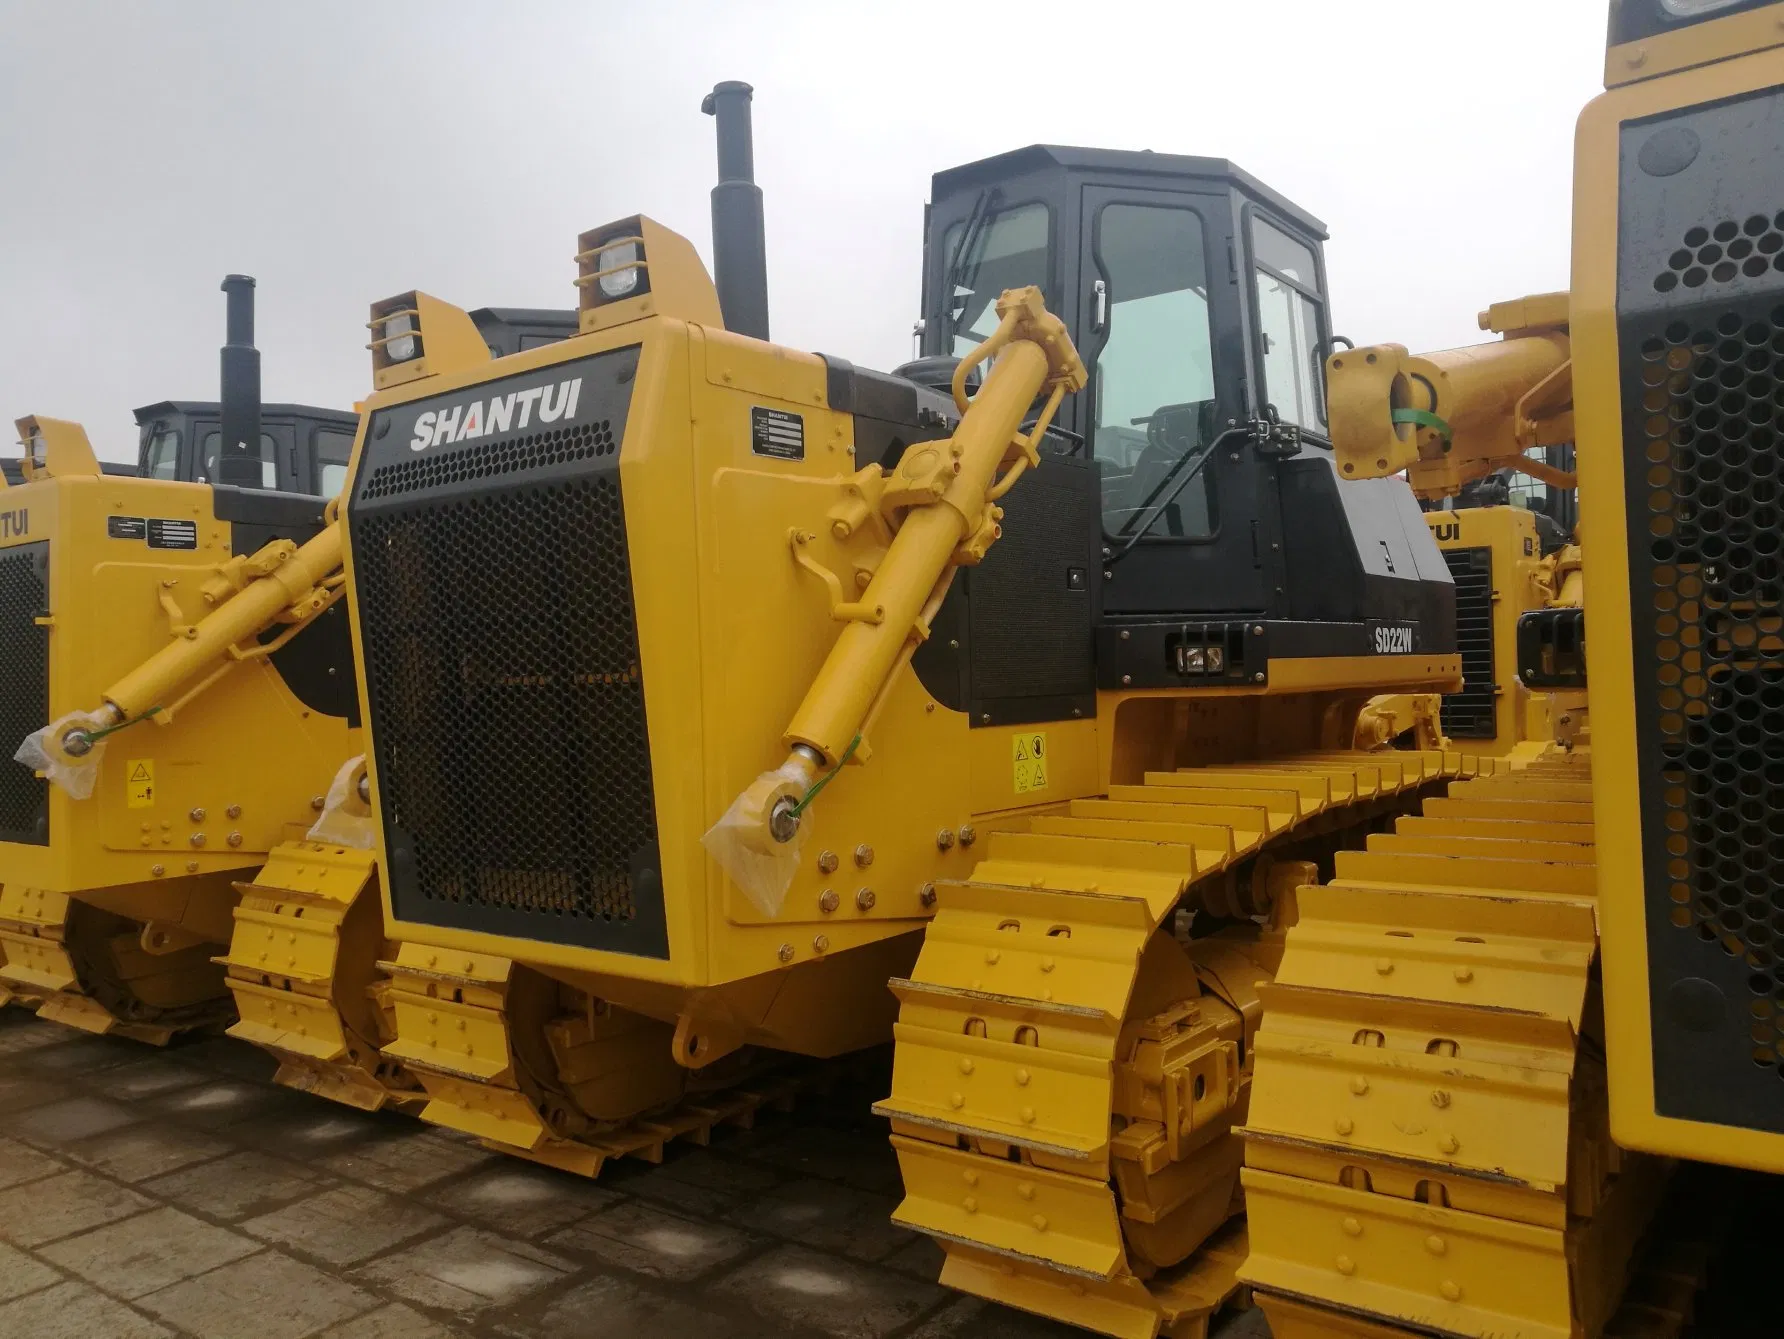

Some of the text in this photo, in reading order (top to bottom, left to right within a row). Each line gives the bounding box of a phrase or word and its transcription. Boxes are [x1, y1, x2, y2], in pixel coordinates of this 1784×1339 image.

[410, 377, 582, 452] SHANTUI
[0, 508, 28, 538] TUI
[1429, 523, 1460, 541] UI
[1375, 626, 1412, 653] SD22W
